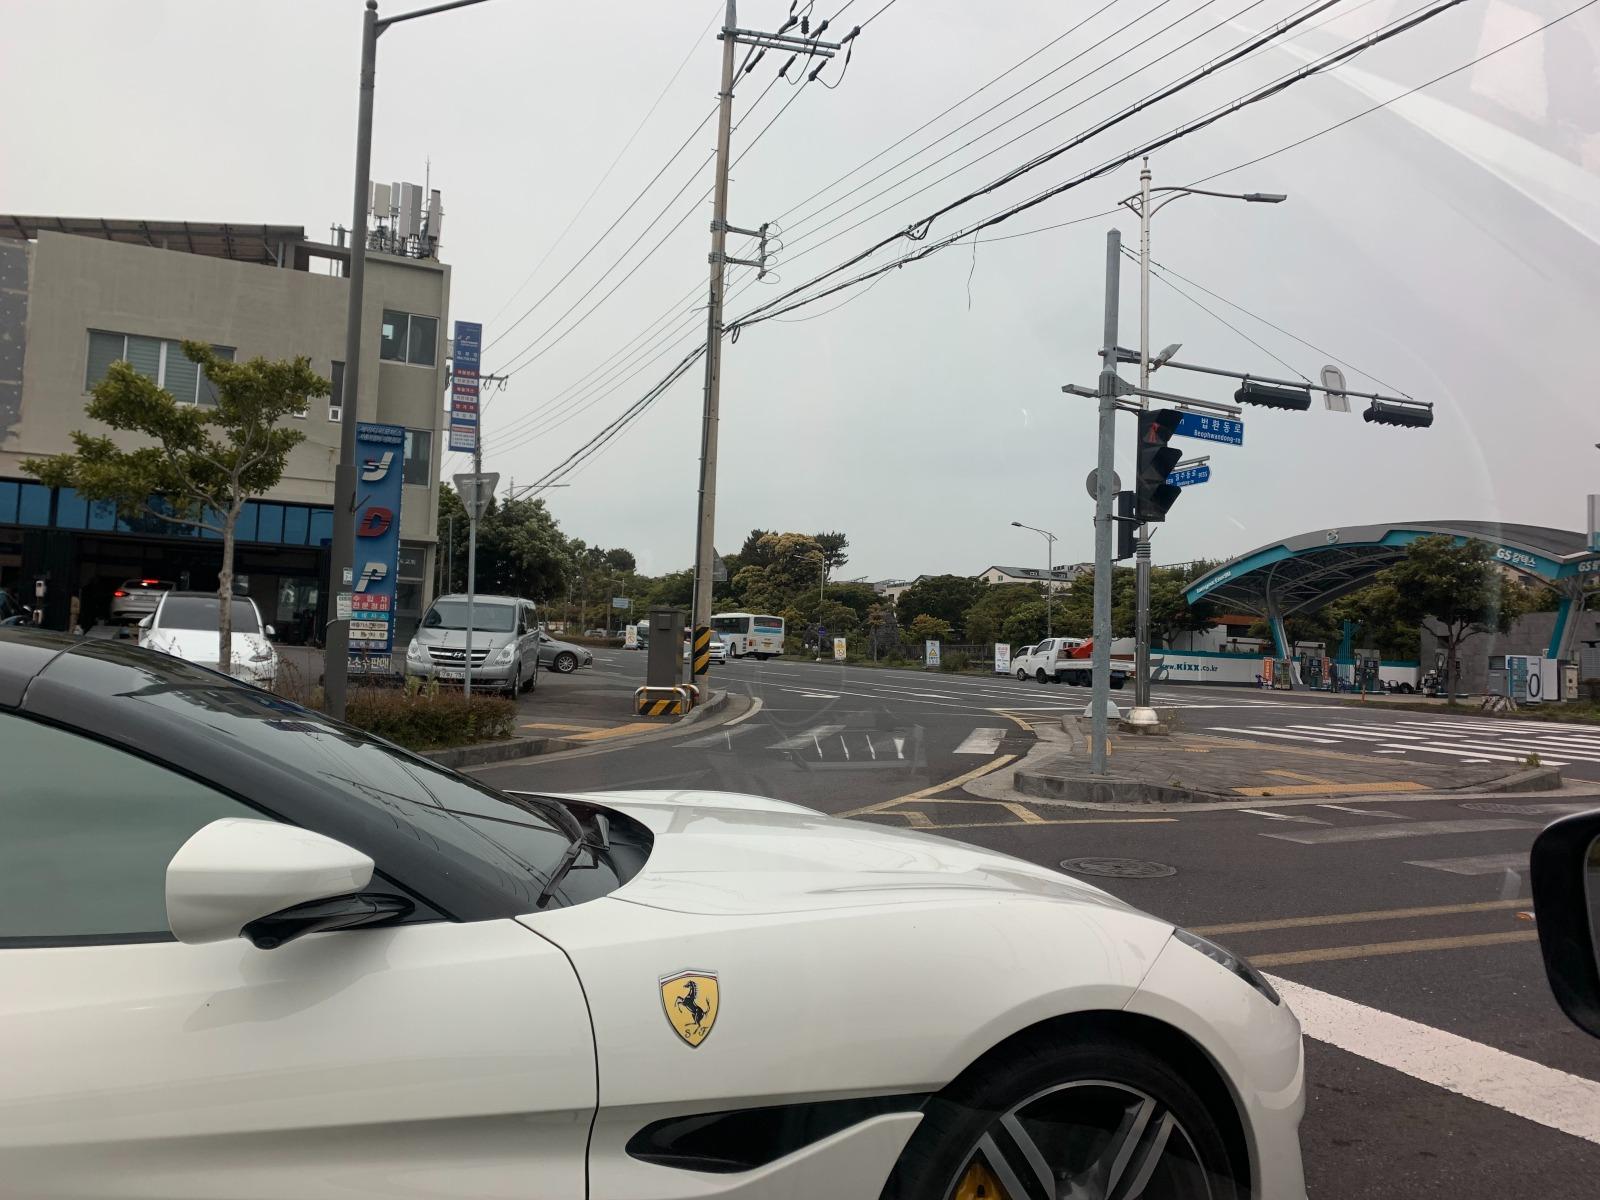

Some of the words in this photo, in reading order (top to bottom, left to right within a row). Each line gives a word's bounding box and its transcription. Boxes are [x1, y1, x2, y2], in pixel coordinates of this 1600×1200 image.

[1201, 417, 1241, 434] 법환동로
[1193, 429, 1241, 444] Beophwandong-ro
[1496, 548, 1512, 561] GS
[1512, 552, 1537, 568] 칼텍스
[352, 602, 388, 610] 전문정비
